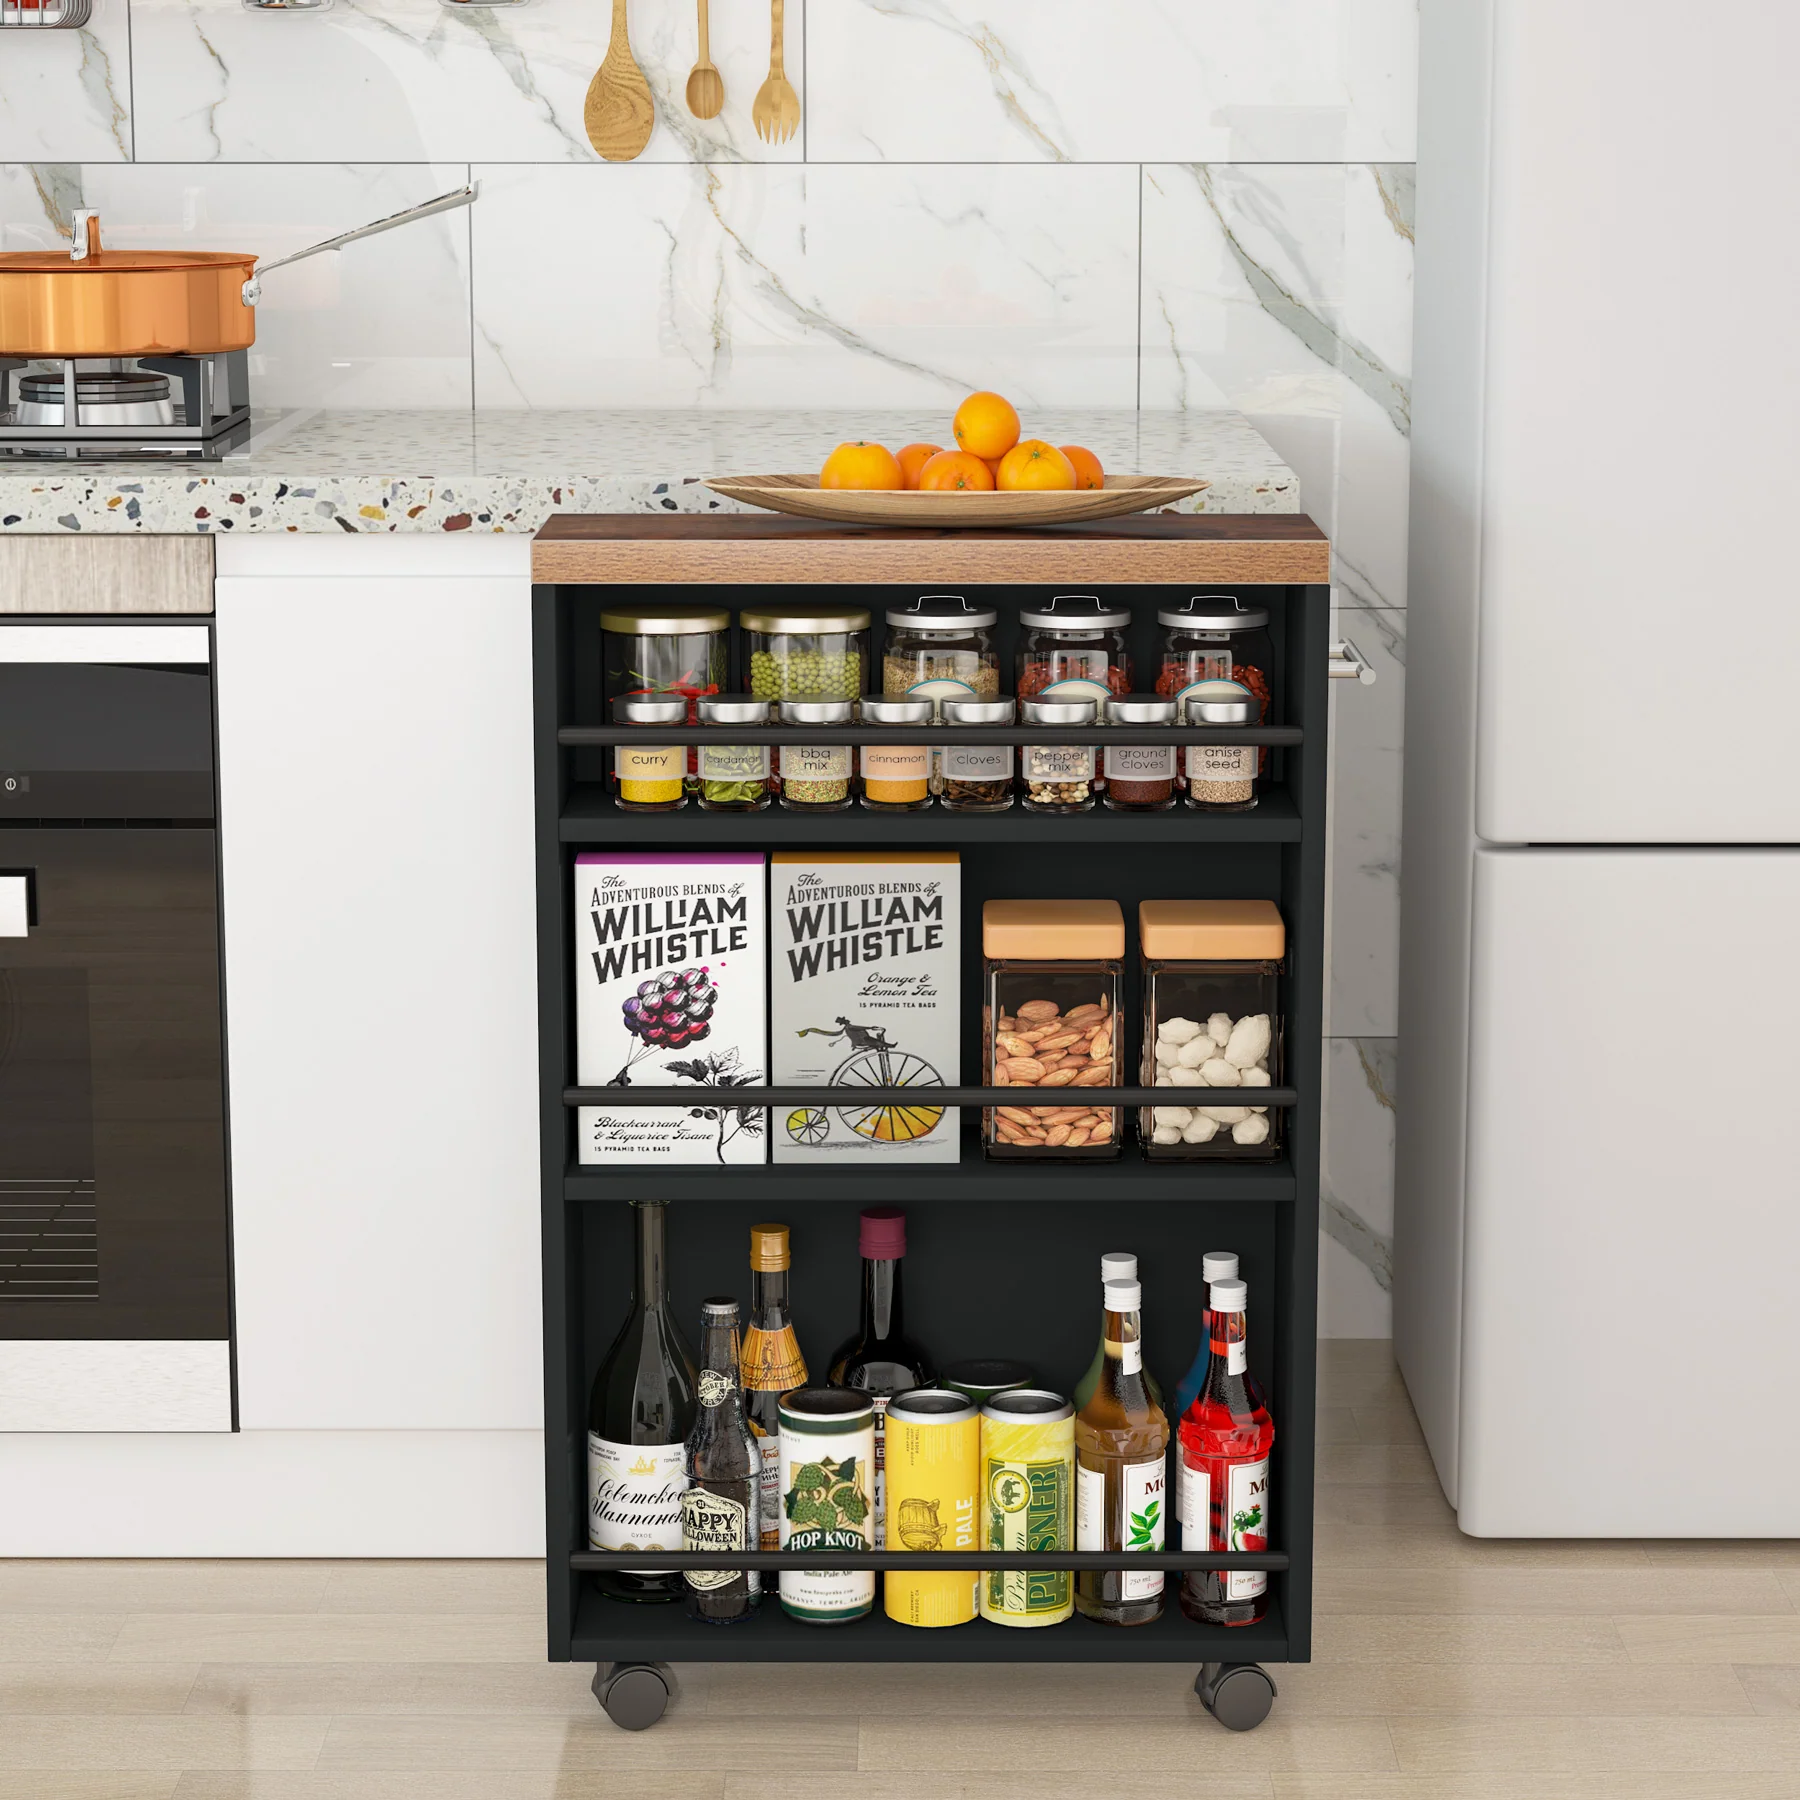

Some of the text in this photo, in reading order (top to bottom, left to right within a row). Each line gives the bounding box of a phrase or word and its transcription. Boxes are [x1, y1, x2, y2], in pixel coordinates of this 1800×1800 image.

[800, 748, 831, 760] bbq
[1034, 751, 1084, 763] pepper
[1118, 748, 1167, 760] ground
[1204, 747, 1242, 757] anise
[631, 754, 668, 766] curry
[804, 760, 828, 770] mix
[868, 754, 925, 764] cinnamon
[956, 754, 1001, 765] cloves
[1121, 760, 1164, 769] cloves
[1205, 759, 1241, 769] seed
[1048, 762, 1071, 772] mix
[601, 874, 627, 889] The
[797, 873, 824, 887] The
[591, 883, 745, 907] ADVENTUROUS BLENDS of
[786, 881, 941, 905] ADVENTUROUS BLENDS of
[590, 896, 747, 945] WILLIAM
[786, 895, 943, 944] WILLIAM
[591, 925, 748, 985] WHISTLE
[786, 924, 943, 983] WHISTLE
[867, 972, 931, 987] Orange &
[857, 984, 938, 996] Lemon Tea
[594, 1116, 685, 1128] Blackcurrant
[594, 1128, 714, 1144] & Liquorice Tisane
[955, 1495, 974, 1547] PALE
[791, 1531, 821, 1551] HOP
[824, 1531, 864, 1550] KNOT
[1028, 1468, 1058, 1606] PISNER
